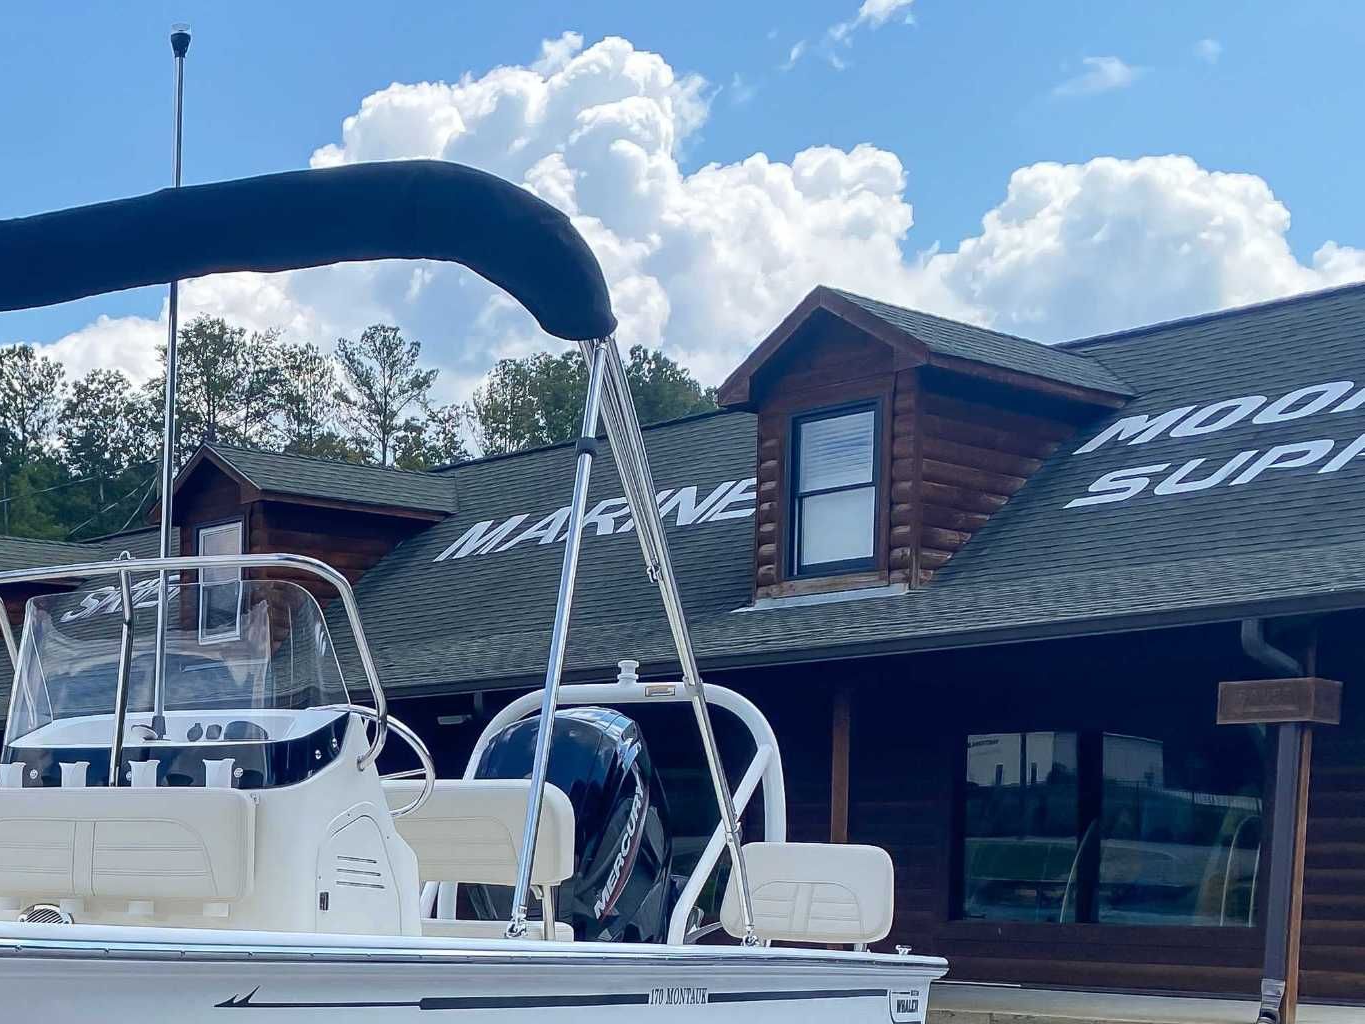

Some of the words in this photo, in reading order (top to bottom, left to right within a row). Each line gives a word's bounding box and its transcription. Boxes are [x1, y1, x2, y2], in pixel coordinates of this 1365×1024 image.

[1073, 381, 1365, 455] MOO
[433, 477, 757, 562] MARINE
[651, 988, 664, 1005] 170
[666, 987, 708, 1005] MONTAUK
